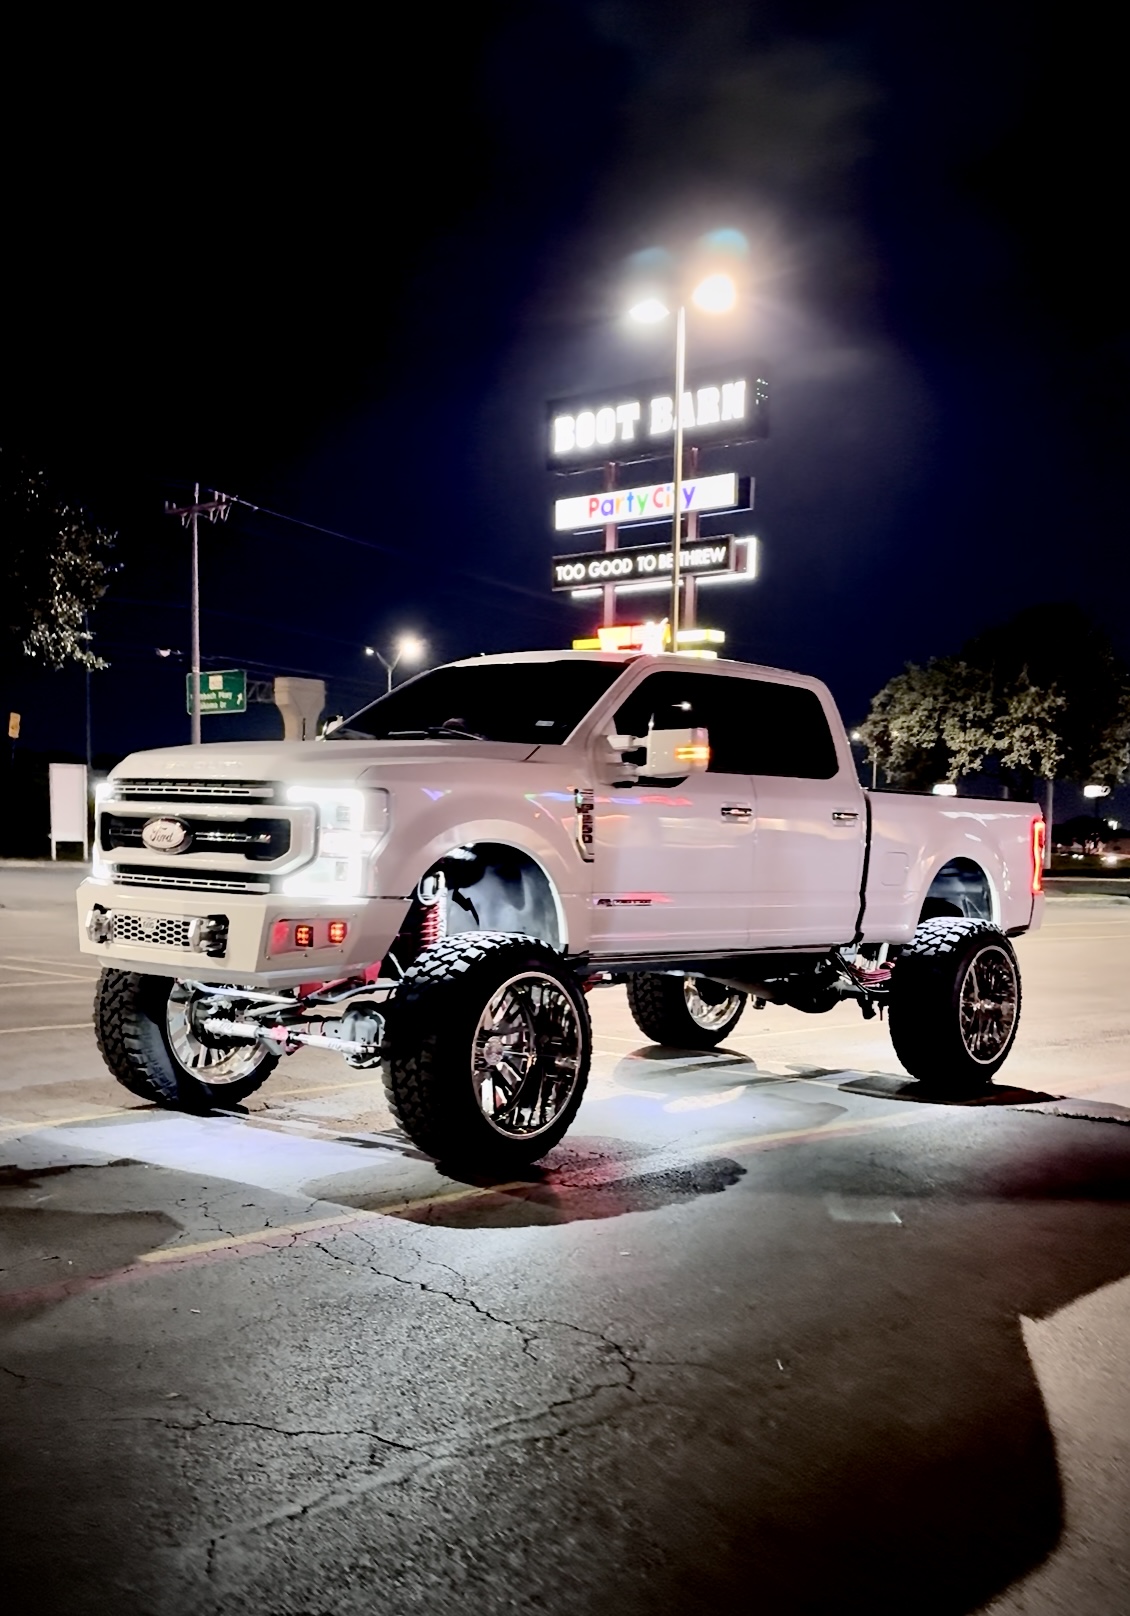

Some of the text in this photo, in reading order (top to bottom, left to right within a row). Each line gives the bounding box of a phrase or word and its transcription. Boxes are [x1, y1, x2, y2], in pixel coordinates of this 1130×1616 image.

[554, 380, 746, 453] BOOT BARN
[589, 486, 696, 518] Party Ciy
[556, 546, 727, 581] TOO GOOD TO BE THREW
[150, 827, 174, 843] Ford
